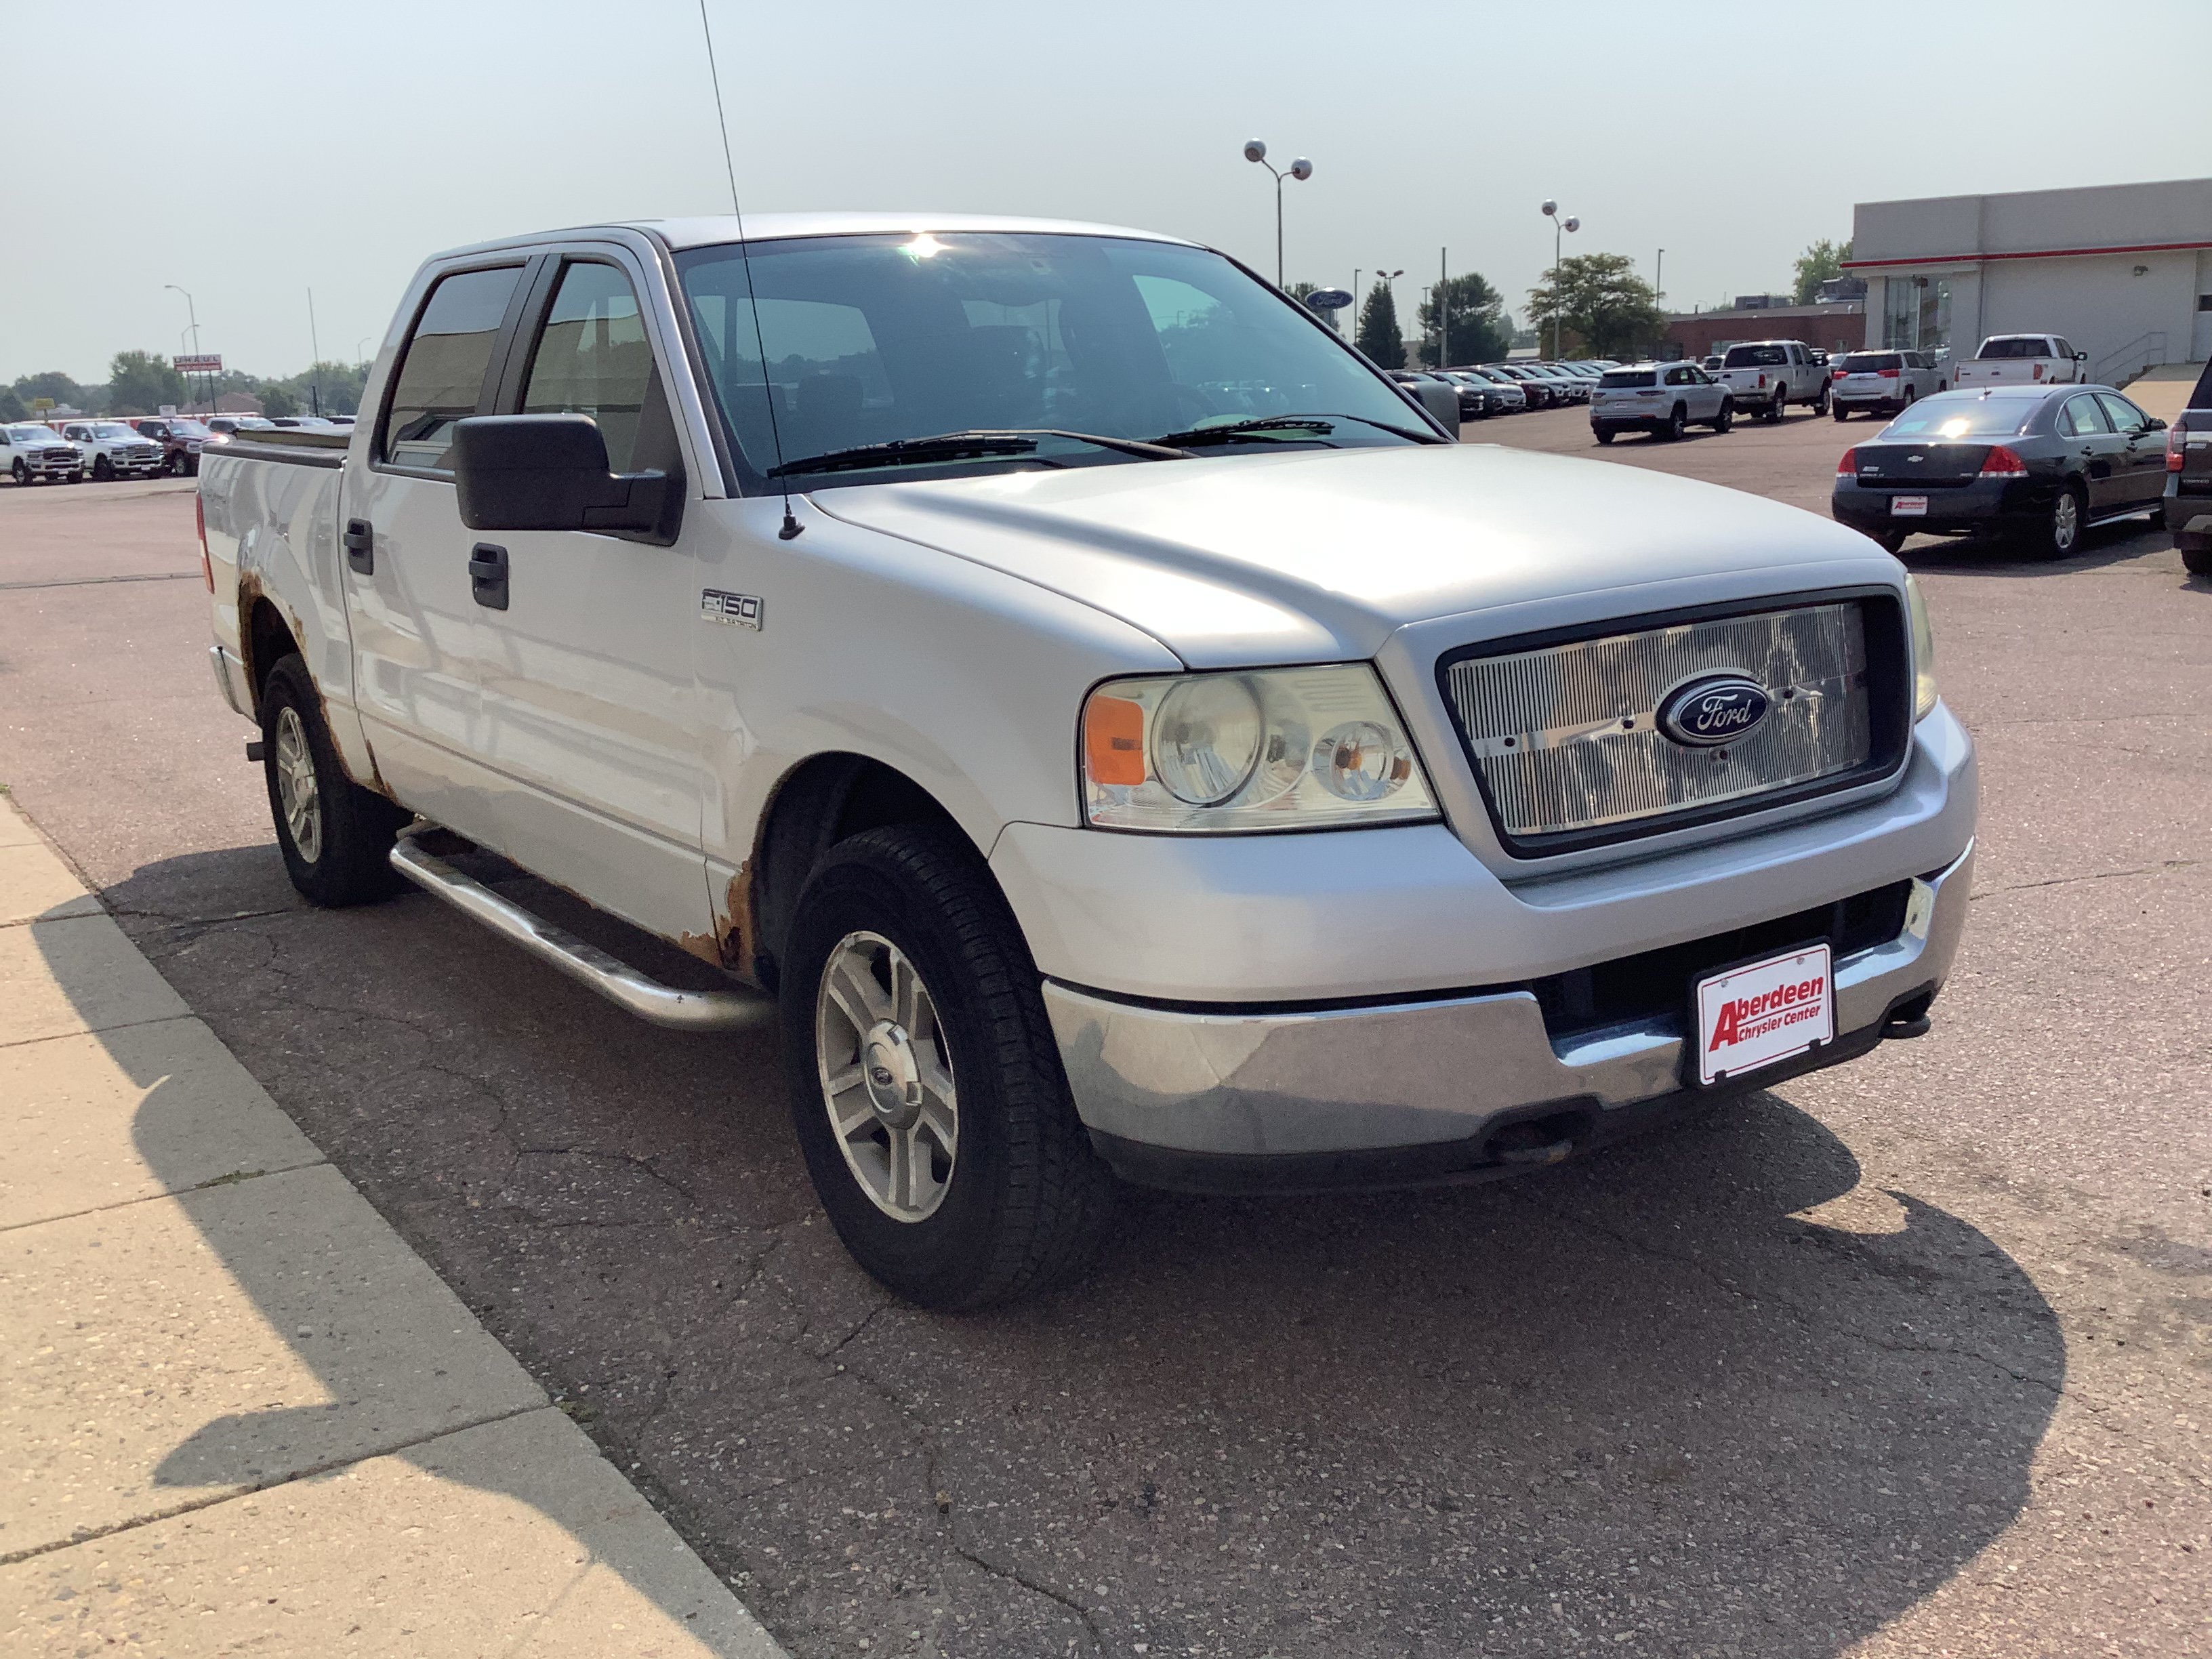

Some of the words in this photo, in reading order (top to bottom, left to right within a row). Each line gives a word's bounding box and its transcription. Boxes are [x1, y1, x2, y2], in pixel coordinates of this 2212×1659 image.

[701, 591, 758, 619] F-150
[1696, 693, 1752, 731] Ford
[1708, 976, 1824, 1052] Aberdeen
[1738, 1017, 1782, 1042] Chrysler
[1784, 1004, 1821, 1027] Center
